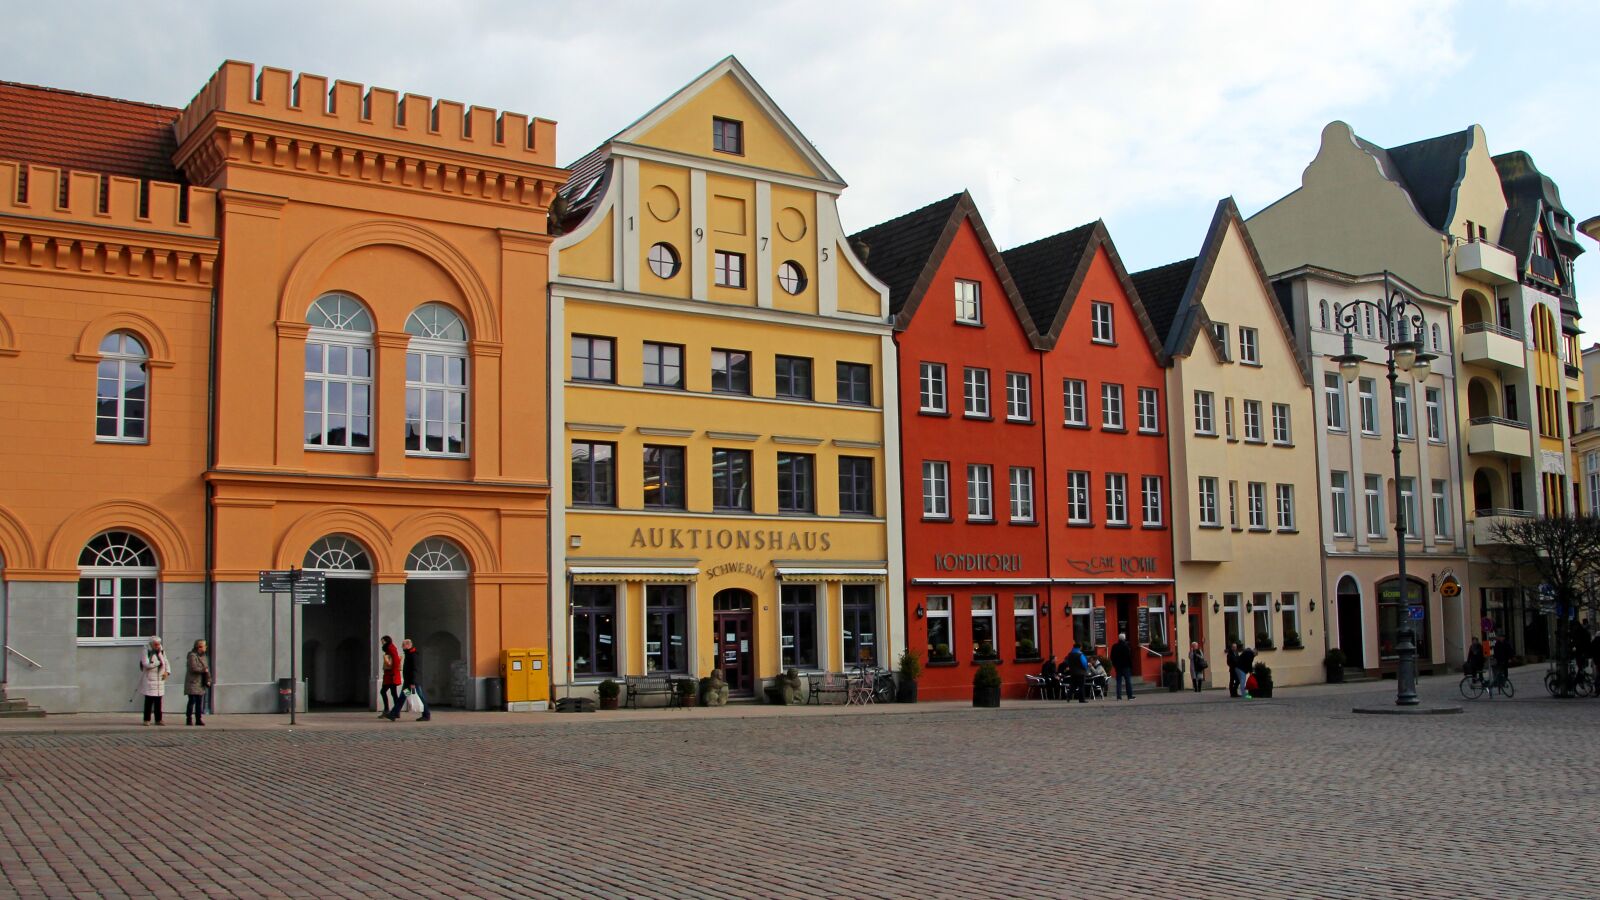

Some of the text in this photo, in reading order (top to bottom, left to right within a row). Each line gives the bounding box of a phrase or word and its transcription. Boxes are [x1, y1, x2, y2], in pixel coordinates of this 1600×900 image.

[627, 215, 829, 262] 1 9 7 5
[630, 527, 831, 551] AUKTIONSHAUS
[706, 561, 766, 580] SCHWERIN
